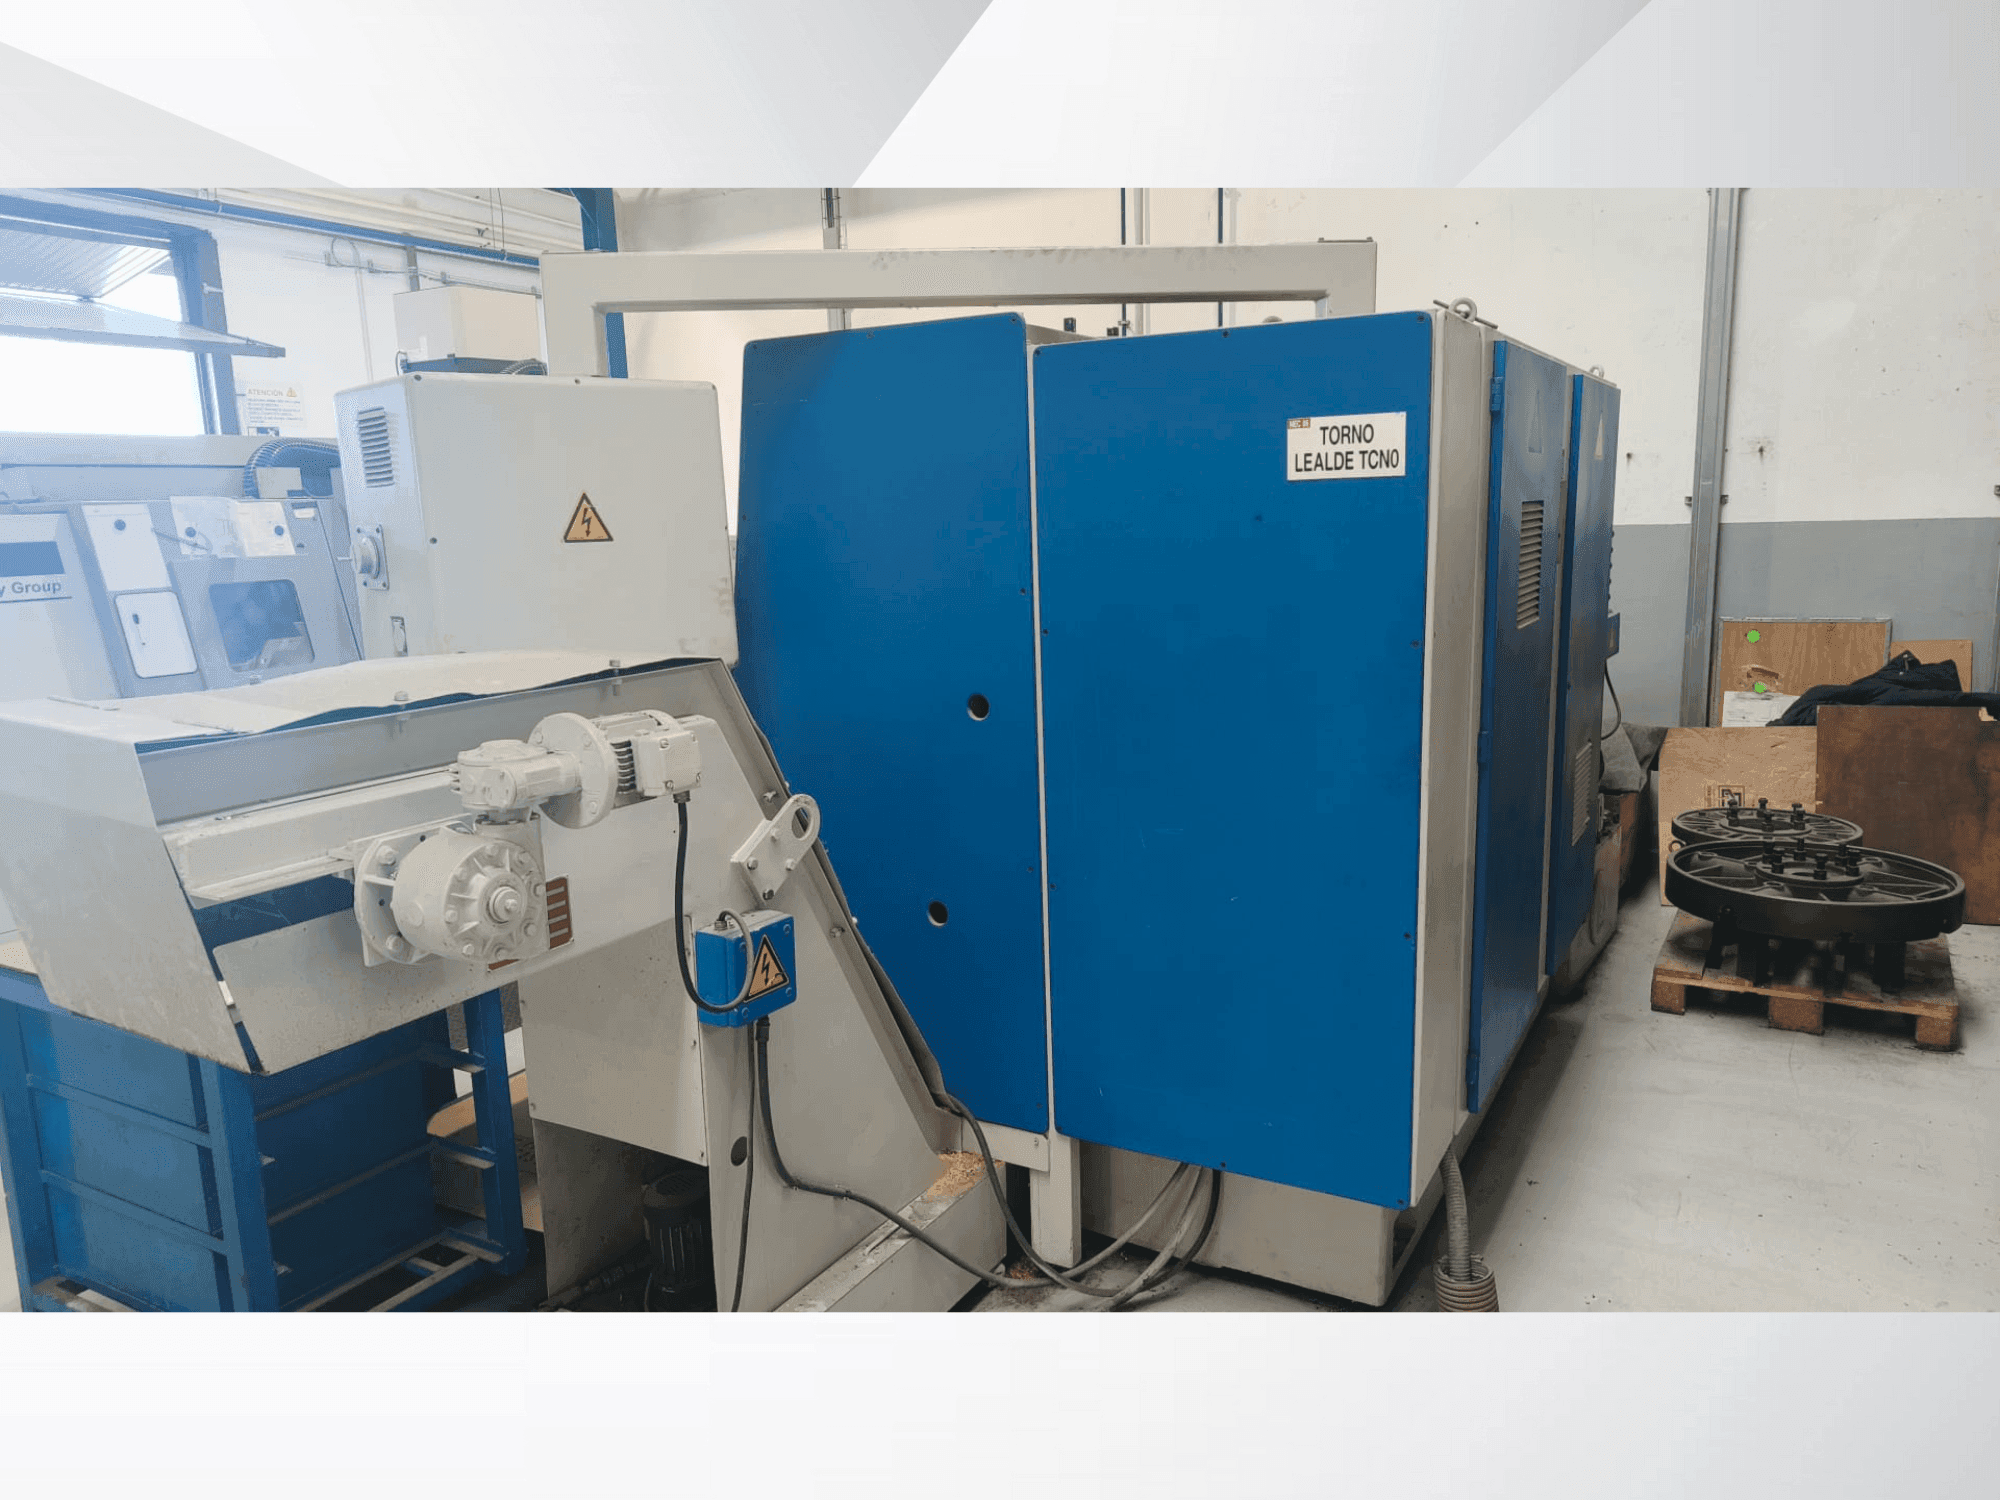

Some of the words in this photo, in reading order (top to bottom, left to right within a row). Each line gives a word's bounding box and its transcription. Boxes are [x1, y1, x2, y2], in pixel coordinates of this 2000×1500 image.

[1319, 423, 1375, 445] TORNO
[1295, 451, 1354, 472] LEALDE
[11, 581, 62, 595] Group
